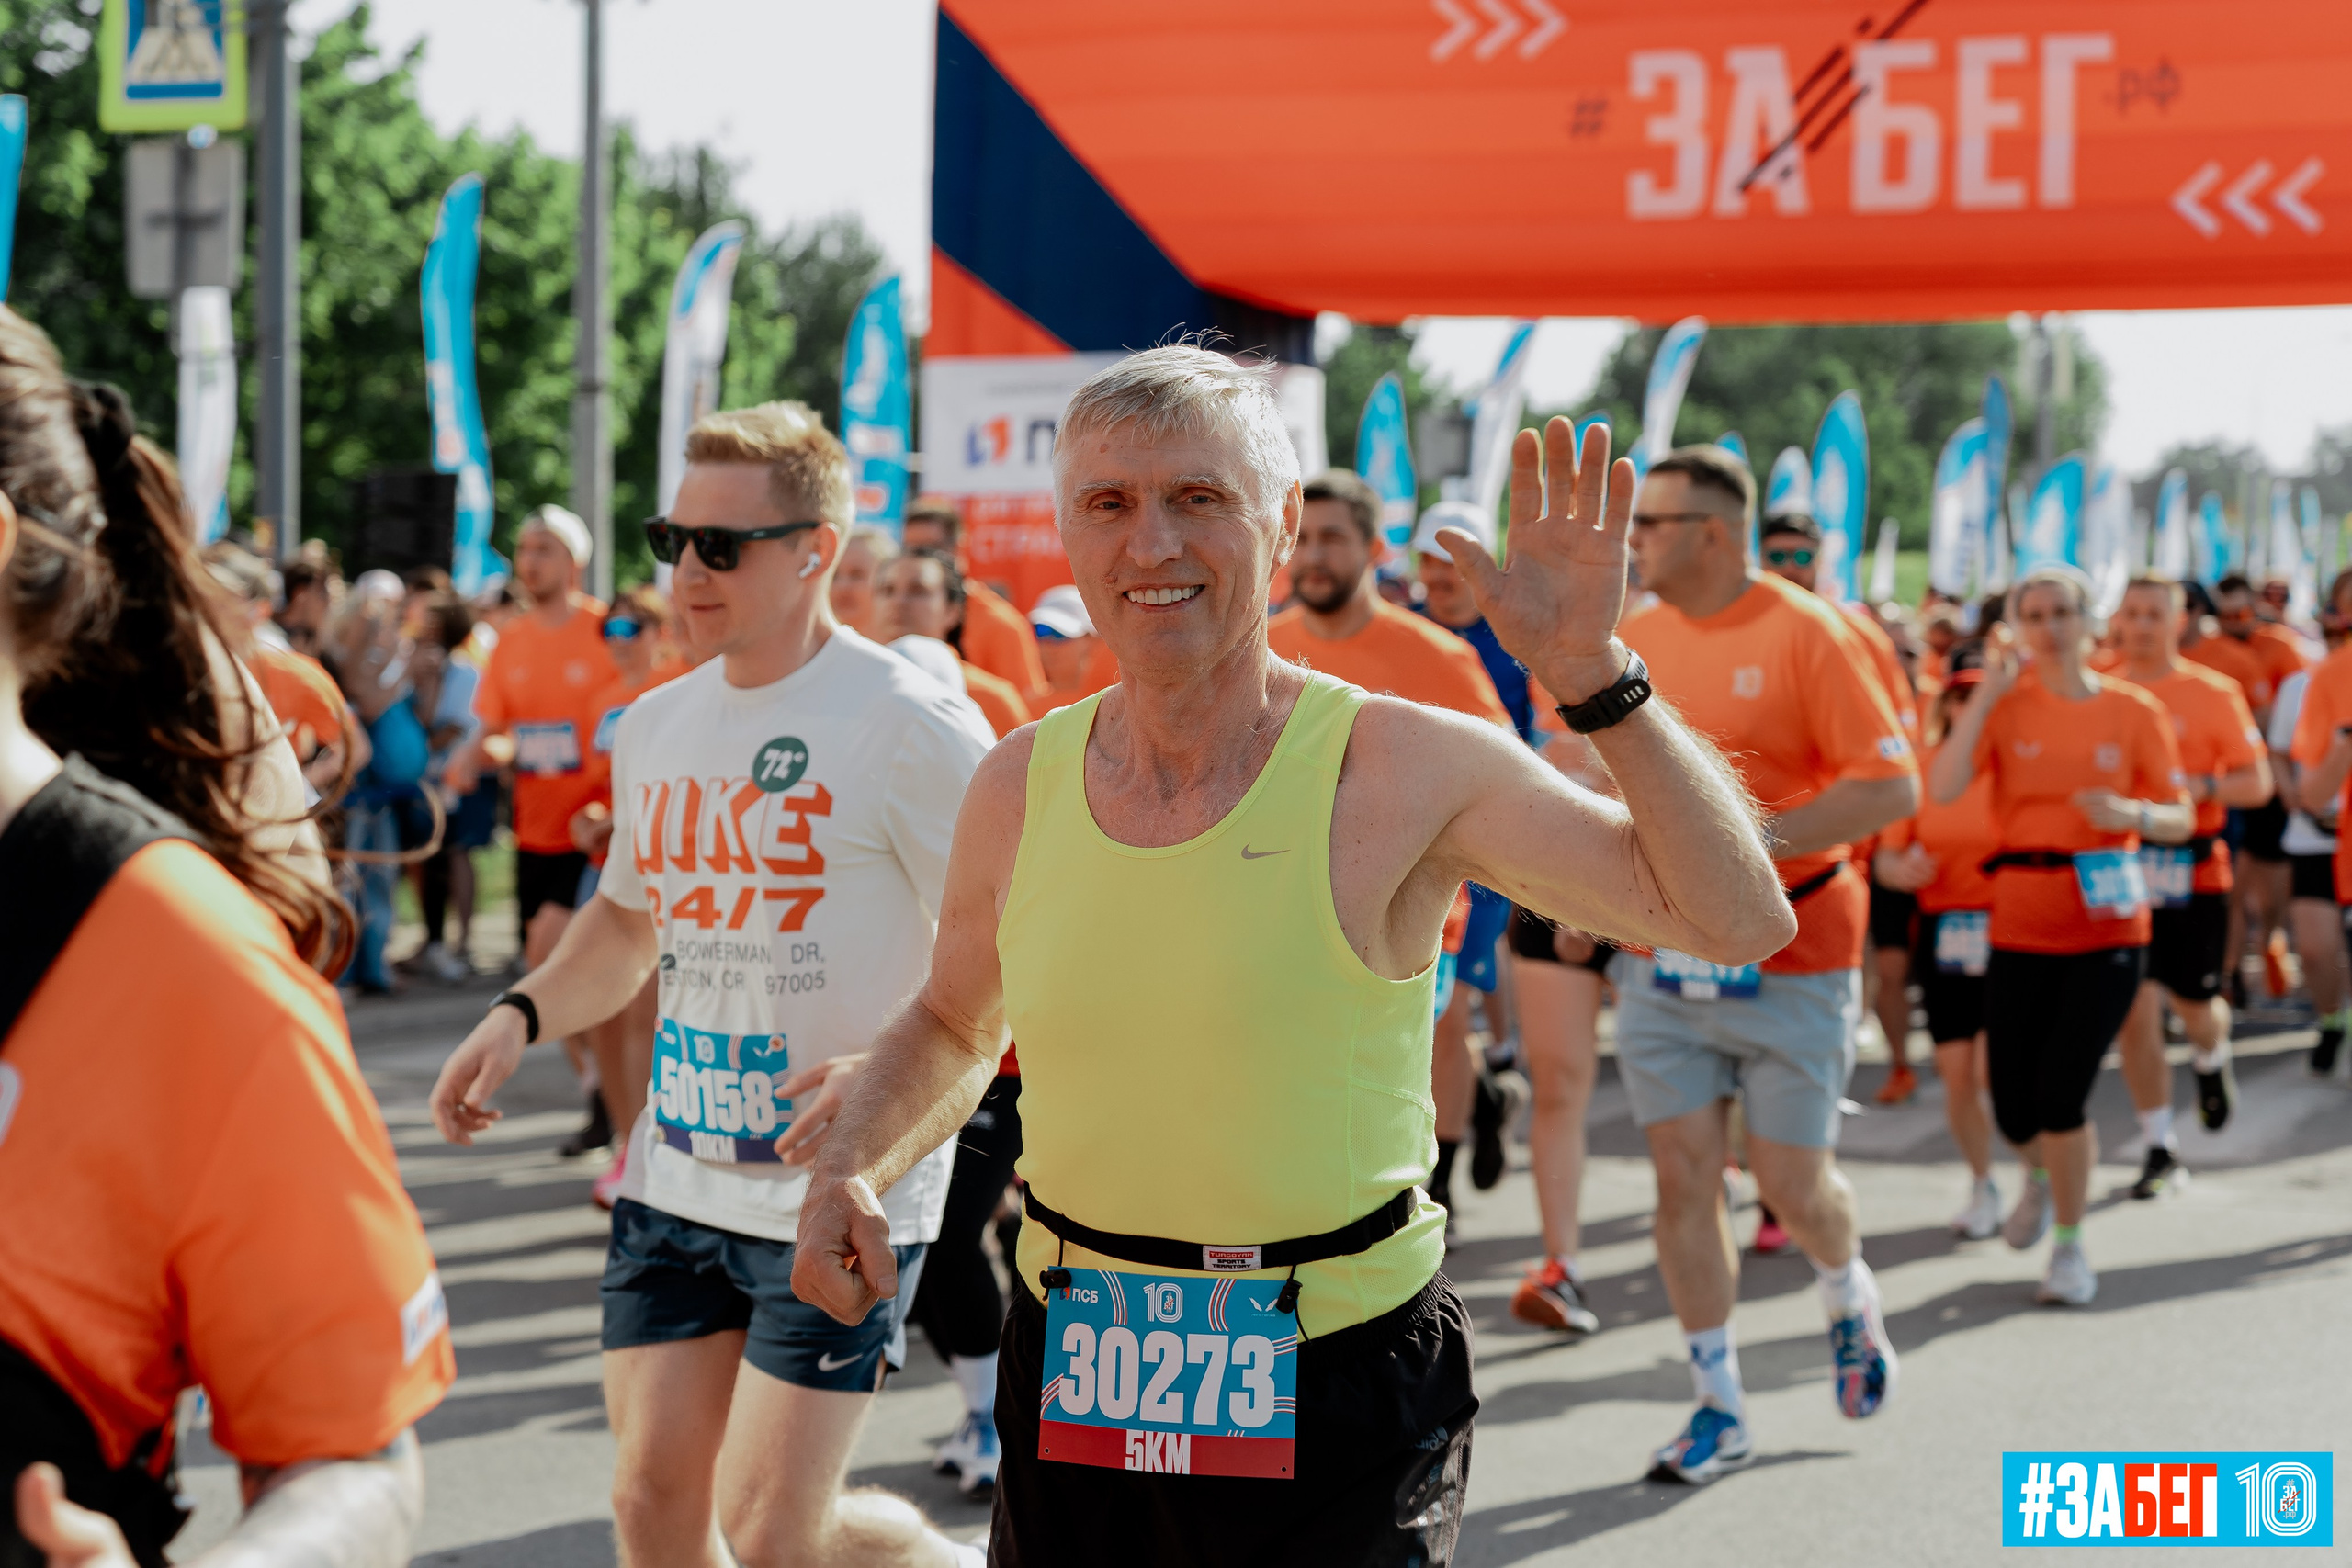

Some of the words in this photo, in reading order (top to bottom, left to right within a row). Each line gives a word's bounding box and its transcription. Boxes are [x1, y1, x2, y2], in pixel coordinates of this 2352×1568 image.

[633, 776, 832, 876] NIKE
[645, 886, 825, 932] 24/7
[677, 940, 772, 964] BOWERMAN
[764, 971, 825, 995] 97005
[660, 1055, 776, 1134] 50158
[1071, 1288, 1099, 1303] ПСБ
[1143, 1282, 1183, 1323] 10
[1058, 1322, 1275, 1428] 30273
[1125, 1429, 1191, 1475] 5KM
